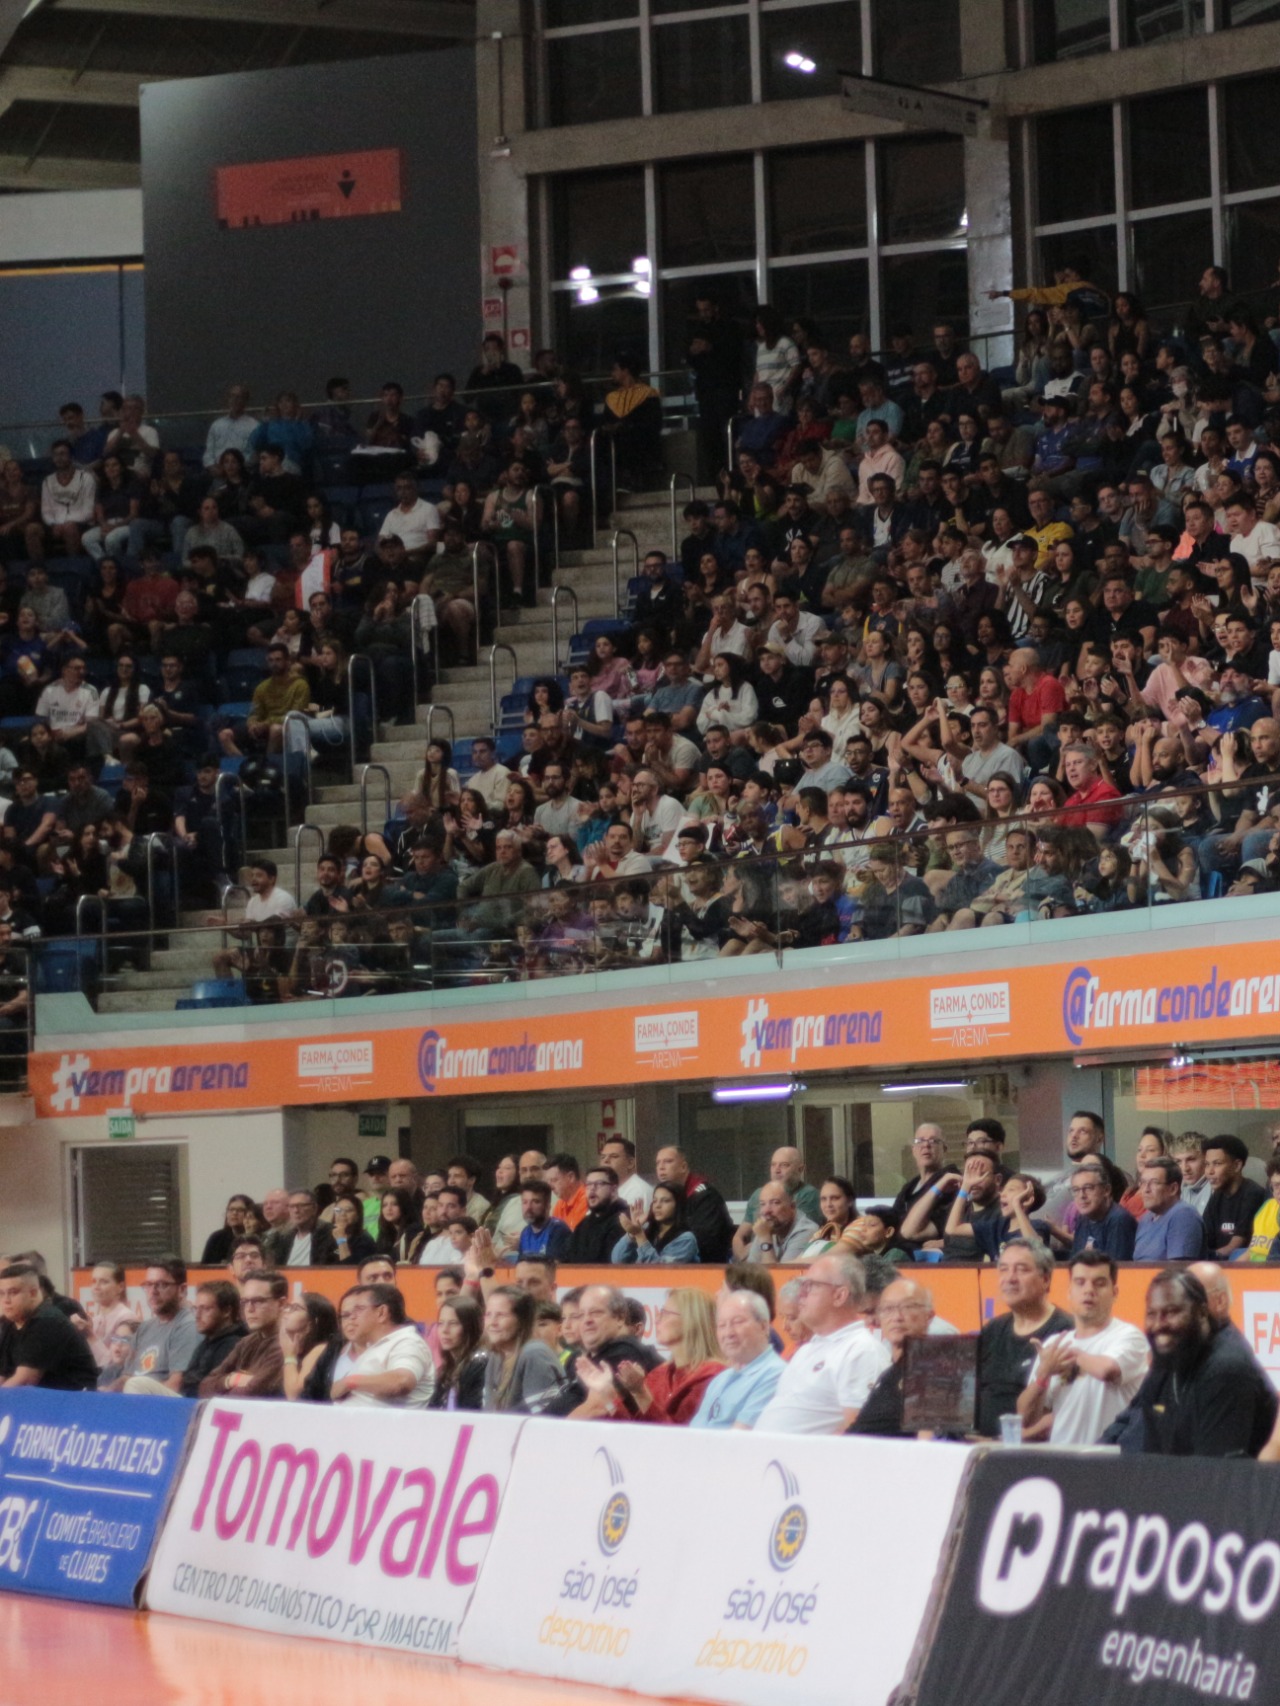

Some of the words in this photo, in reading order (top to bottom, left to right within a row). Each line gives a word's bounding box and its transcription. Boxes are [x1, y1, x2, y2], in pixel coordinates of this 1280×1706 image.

[933, 992, 967, 1013] FARMA
[970, 988, 1006, 1009] CONDE
[637, 1022, 664, 1039] FARMA
[667, 1019, 696, 1036] CONDE
[740, 999, 882, 1067] #vempraarena
[951, 1028, 989, 1047] ARENA
[301, 1050, 333, 1065] FARMA
[336, 1048, 369, 1064] CONDE
[417, 1029, 583, 1092] @farmacondearena
[652, 1050, 682, 1067] ARENA
[51, 1054, 248, 1111] #vempraarena
[12, 1423, 84, 1473] FORMAÇÃO
[82, 1432, 108, 1468] DE
[100, 1436, 169, 1476] ATLETAS
[191, 1409, 499, 1586] Tomovale
[46, 1509, 92, 1545] COMITÊ
[67, 1550, 111, 1583] CLUBES
[559, 1561, 596, 1602] são
[593, 1569, 638, 1612] josé
[173, 1562, 226, 1602] CENTRO
[225, 1573, 247, 1604] DE
[341, 1603, 381, 1640] POR
[380, 1611, 453, 1653] IMAGEM
[723, 1580, 760, 1622] são
[763, 1582, 817, 1631] josé
[538, 1611, 631, 1658] desportivo
[696, 1631, 809, 1678] desportivo
[1101, 1630, 1257, 1700] engenharia
